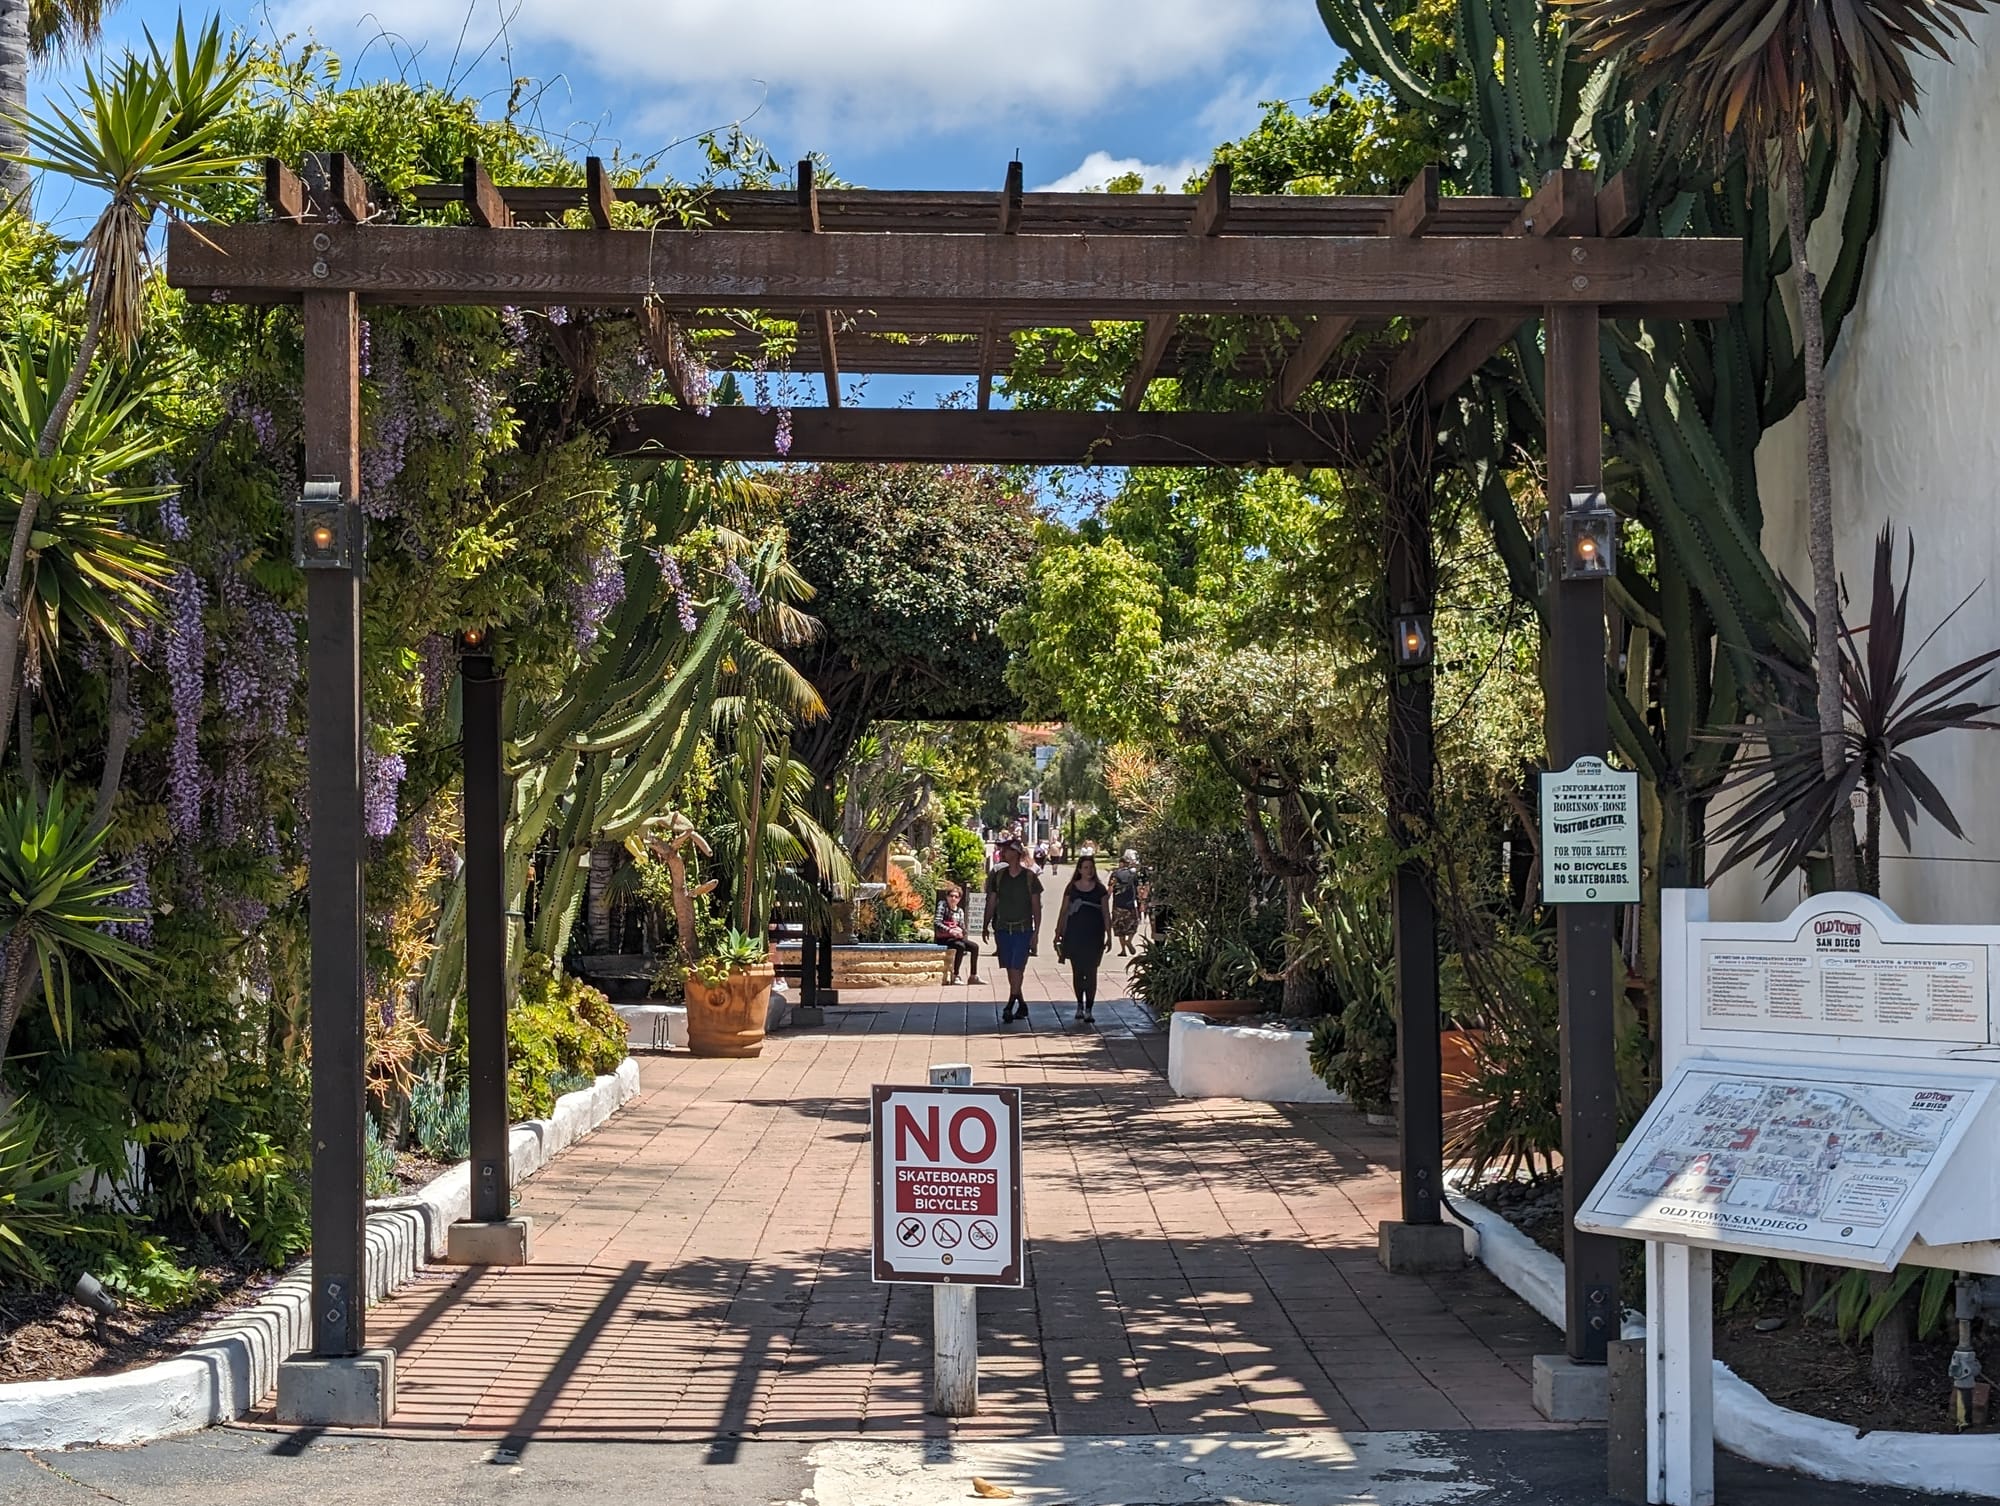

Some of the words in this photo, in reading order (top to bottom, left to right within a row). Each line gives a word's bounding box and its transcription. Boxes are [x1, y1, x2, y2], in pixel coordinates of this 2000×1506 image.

[1562, 784, 1626, 792] INFORMATION
[1553, 820, 1589, 834] VISITOR
[1554, 846, 1569, 857] FOR
[1571, 846, 1592, 857] YOUR
[1554, 863, 1570, 871] NO
[1574, 862, 1627, 871] BICYCLES
[1554, 874, 1566, 884] NO
[1568, 873, 1629, 884] SKATEBOARDS.
[1816, 938, 1832, 947] SAN
[1835, 938, 1861, 948] DIEGO
[895, 1105, 997, 1164] NO
[898, 1170, 995, 1184] SKATEBOARDS
[912, 1184, 981, 1198] SCOOTERS
[915, 1198, 978, 1211] BICYCLES
[1659, 1206, 1688, 1217] OLD
[1690, 1209, 1733, 1222] TOWN
[1732, 1215, 1760, 1225] SAN
[1760, 1218, 1808, 1231] DIEGO
